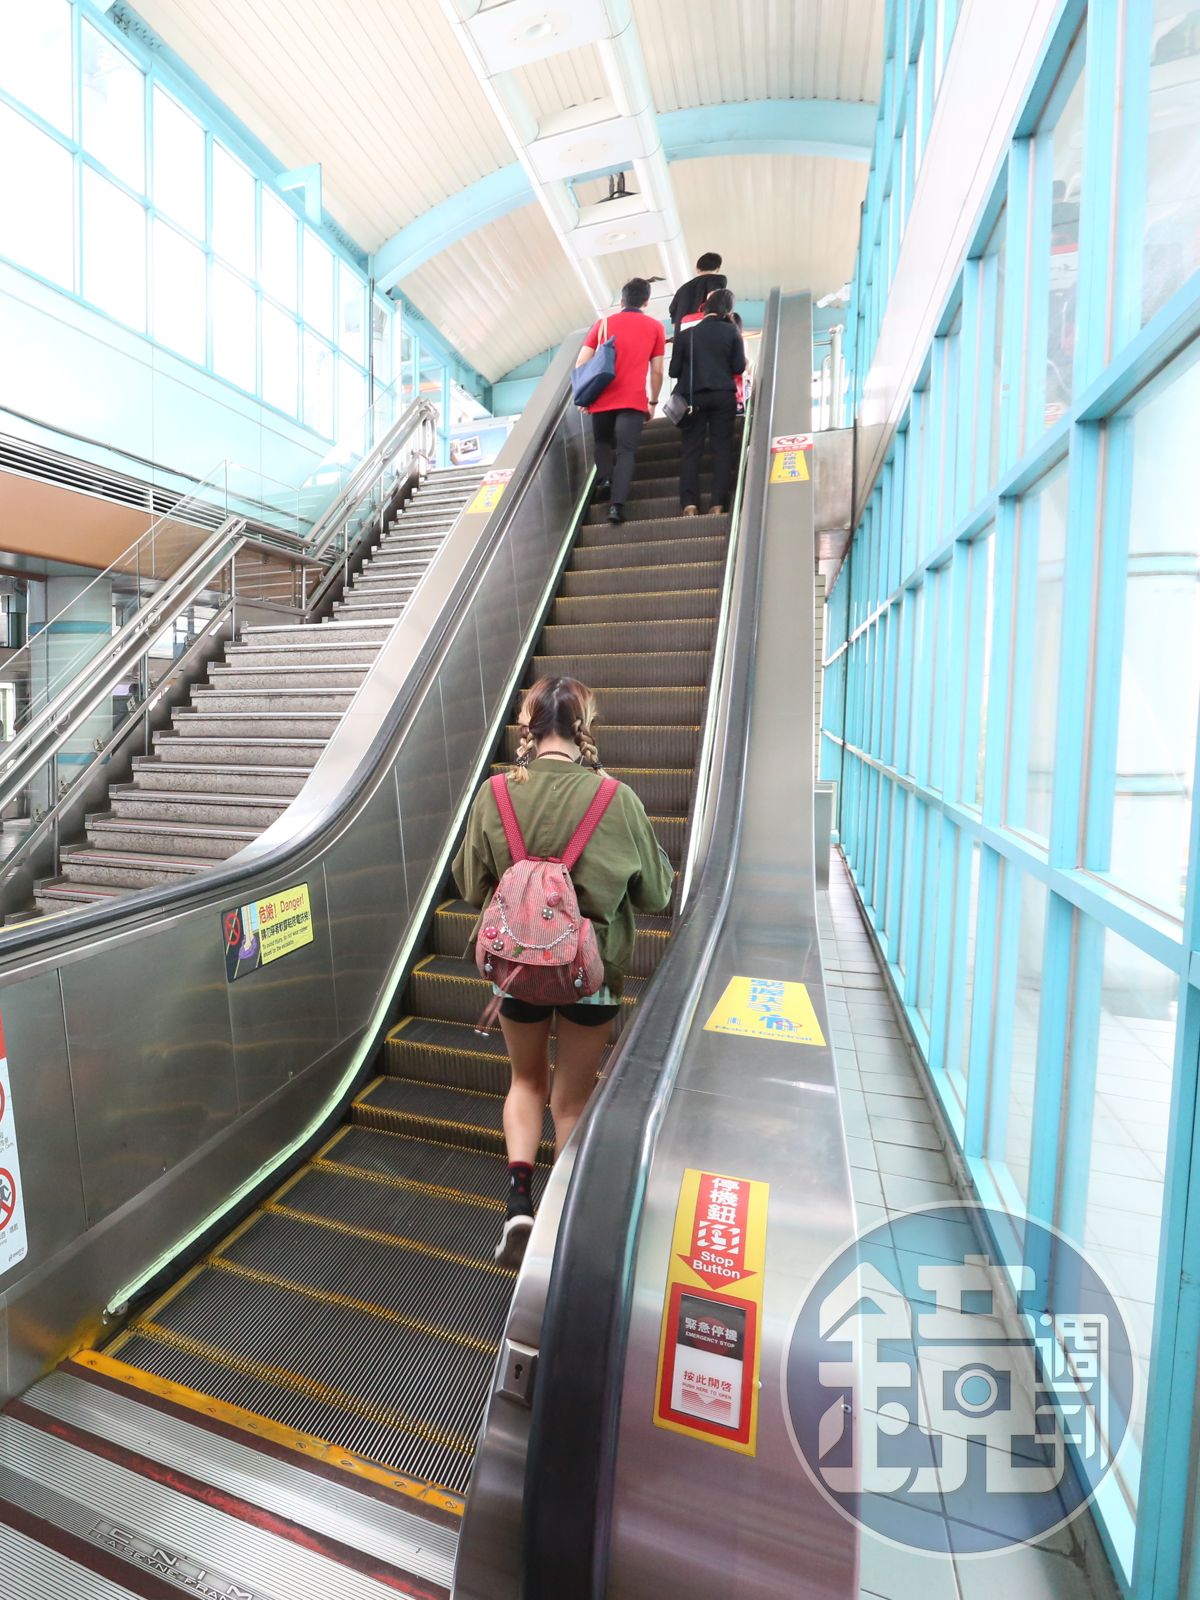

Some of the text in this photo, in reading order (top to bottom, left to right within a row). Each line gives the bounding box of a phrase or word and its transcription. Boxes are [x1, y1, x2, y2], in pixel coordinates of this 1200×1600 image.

[280, 893, 305, 913] Danger!
[707, 1177, 740, 1225] 停機鈕
[701, 1250, 734, 1267] Stop
[692, 1260, 740, 1279] Button
[685, 1317, 738, 1342] 緊急停機
[685, 1331, 735, 1348] EMERGENCY STOP
[682, 1381, 695, 1389] PUSH
[696, 1385, 708, 1394] HERE
[124, 1546, 178, 1577] SEYNE
